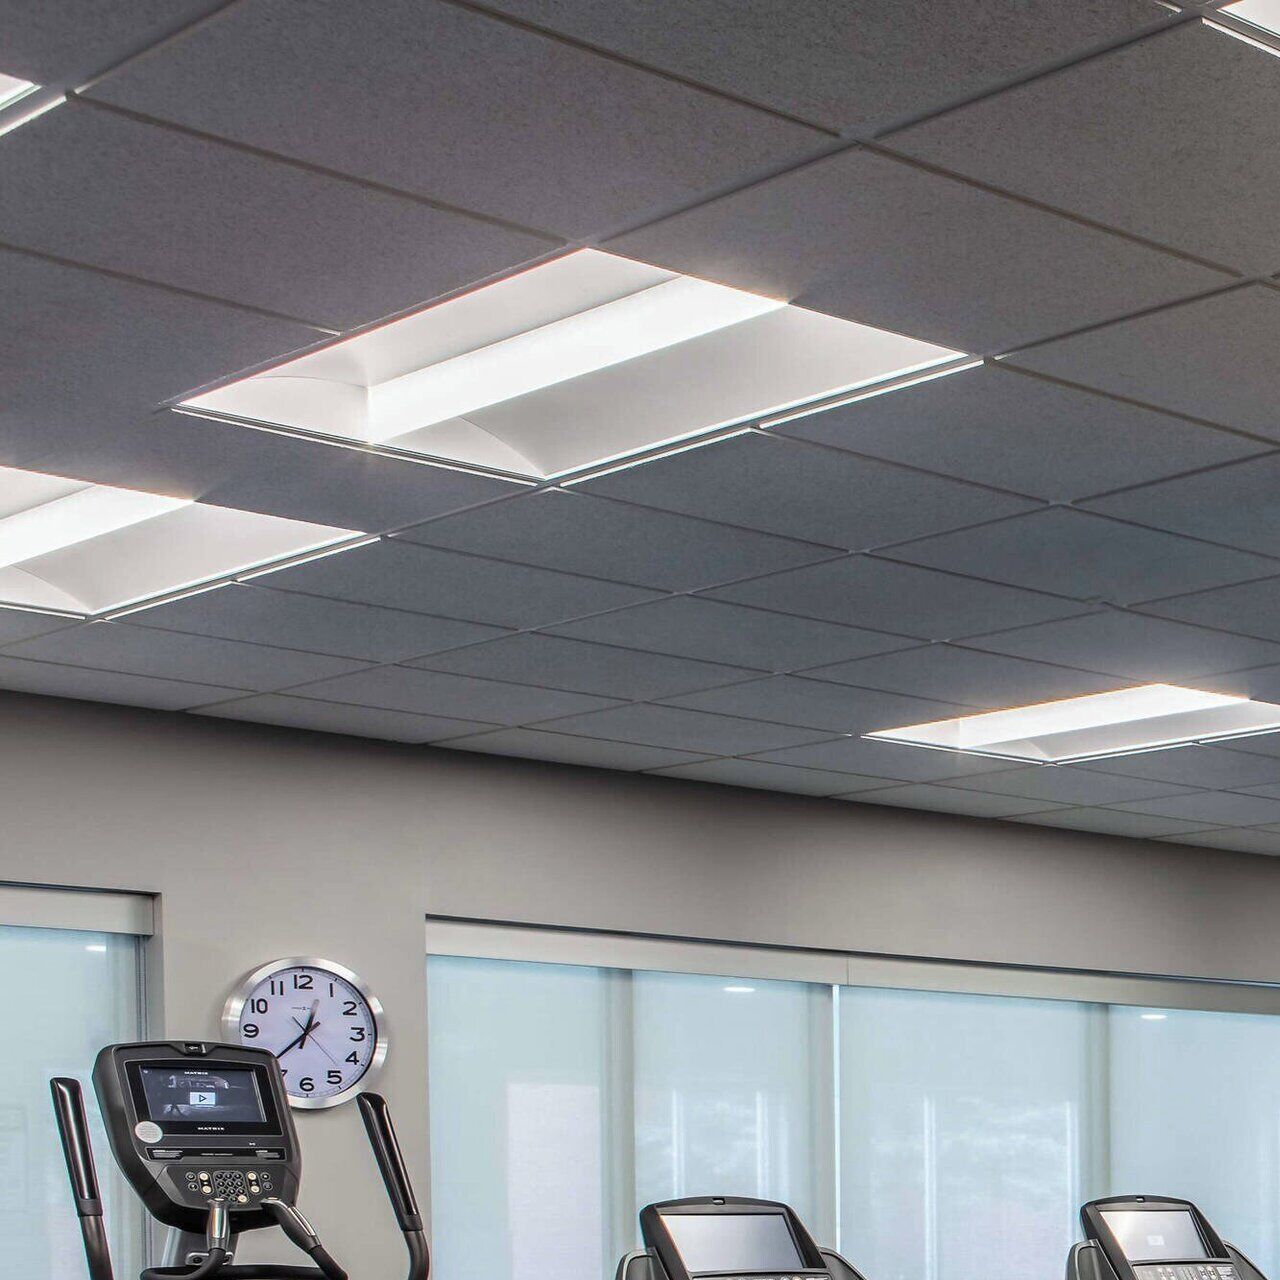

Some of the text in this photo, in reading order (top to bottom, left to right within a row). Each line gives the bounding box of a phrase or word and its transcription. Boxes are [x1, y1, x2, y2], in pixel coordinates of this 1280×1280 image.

[270, 980, 284, 996] 11
[294, 974, 314, 990] 12
[329, 983, 334, 998] 1
[250, 998, 268, 1014] 10
[342, 1001, 357, 1016] 2
[243, 1023, 260, 1038] 9
[349, 1027, 365, 1042] 3
[345, 1050, 360, 1065] 4
[299, 1077, 314, 1092] 6
[326, 1070, 342, 1085] 5
